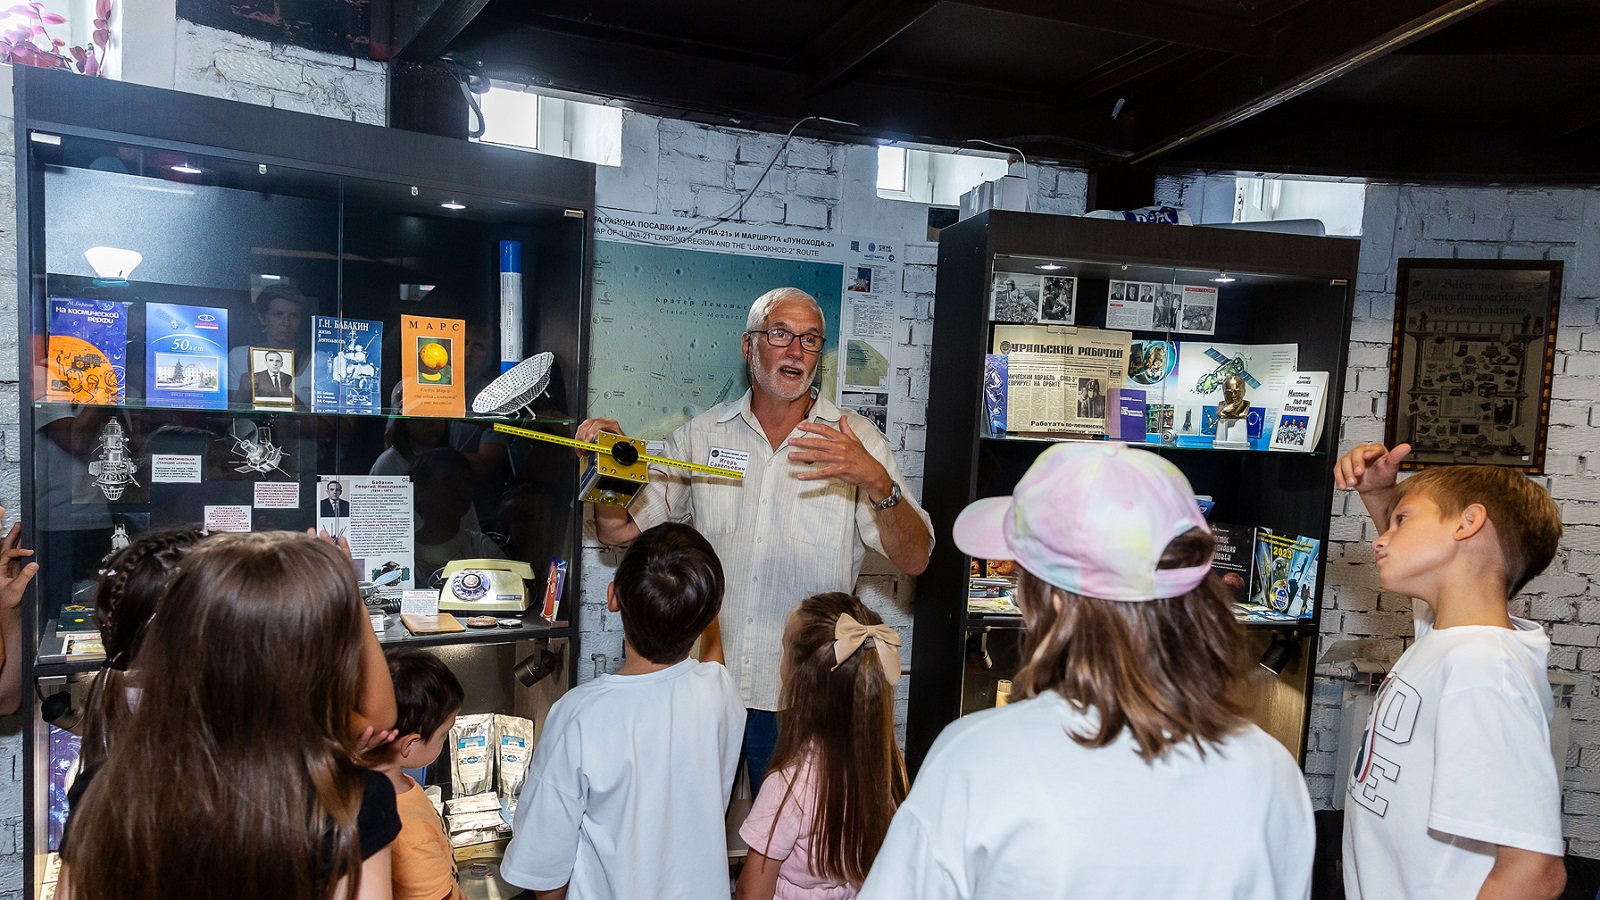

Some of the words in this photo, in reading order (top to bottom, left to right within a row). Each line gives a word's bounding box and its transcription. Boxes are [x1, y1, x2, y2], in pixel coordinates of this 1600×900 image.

[604, 217, 637, 228] РАЙОНА
[638, 221, 675, 232] ПОСАДКИ
[741, 233, 782, 243] МАРШРУТА
[655, 234, 686, 243] LANDING
[687, 238, 715, 246] REGION
[732, 242, 746, 250] THE
[796, 249, 820, 257] ROUTE
[655, 297, 695, 306] кратер
[68, 307, 119, 319] космической
[87, 316, 114, 324] верфи
[318, 318, 332, 328] Г.Н.
[334, 320, 369, 331] БАБАКИН
[409, 320, 460, 332] МАРС
[171, 337, 190, 351] 50
[1011, 343, 1074, 355] УРАЛЬСКИЙ
[1078, 346, 1123, 359] РАБОЧИЙ
[1030, 420, 1065, 428] Работать
[710, 461, 746, 472] Савельевич
[719, 458, 737, 466] Игорь
[1214, 535, 1230, 544] ОСМОС
[1273, 546, 1293, 559] 2023
